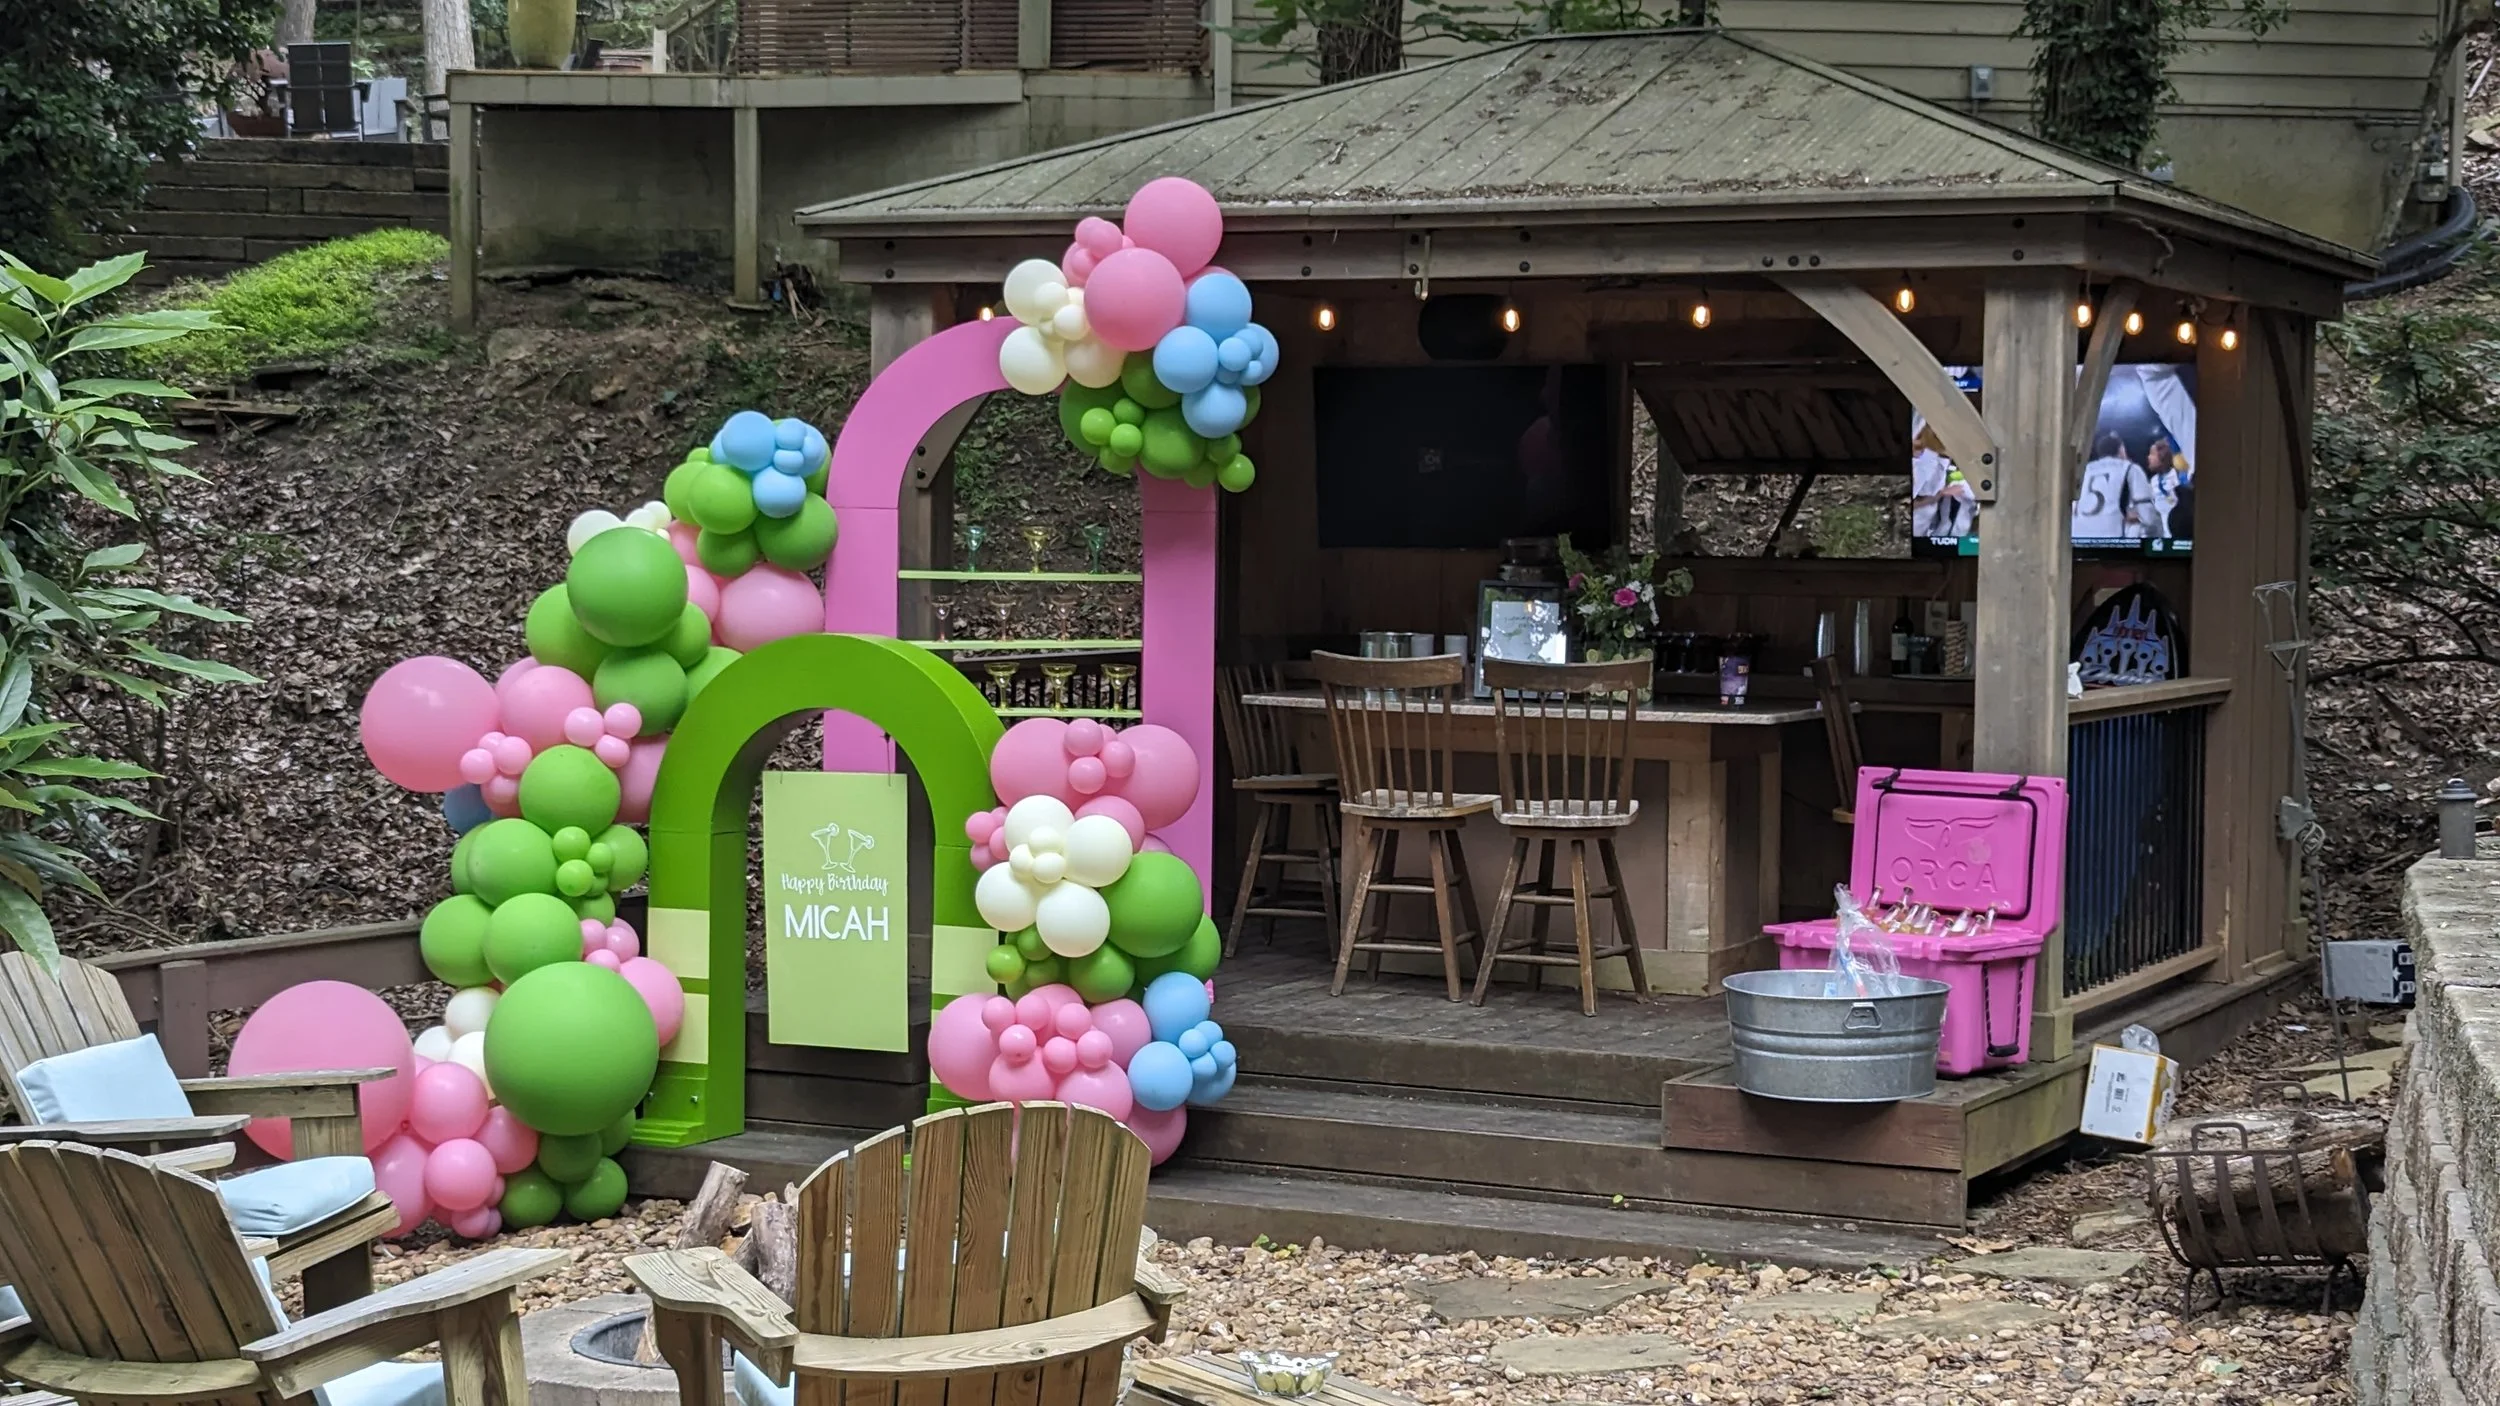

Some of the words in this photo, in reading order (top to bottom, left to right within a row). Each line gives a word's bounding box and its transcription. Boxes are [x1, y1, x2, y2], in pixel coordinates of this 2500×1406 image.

[1930, 537, 1958, 546] TUDN
[782, 873, 825, 896] Happy
[827, 872, 888, 896] Birthday
[1890, 856, 1999, 893] ORCA
[785, 904, 889, 941] MICAH
